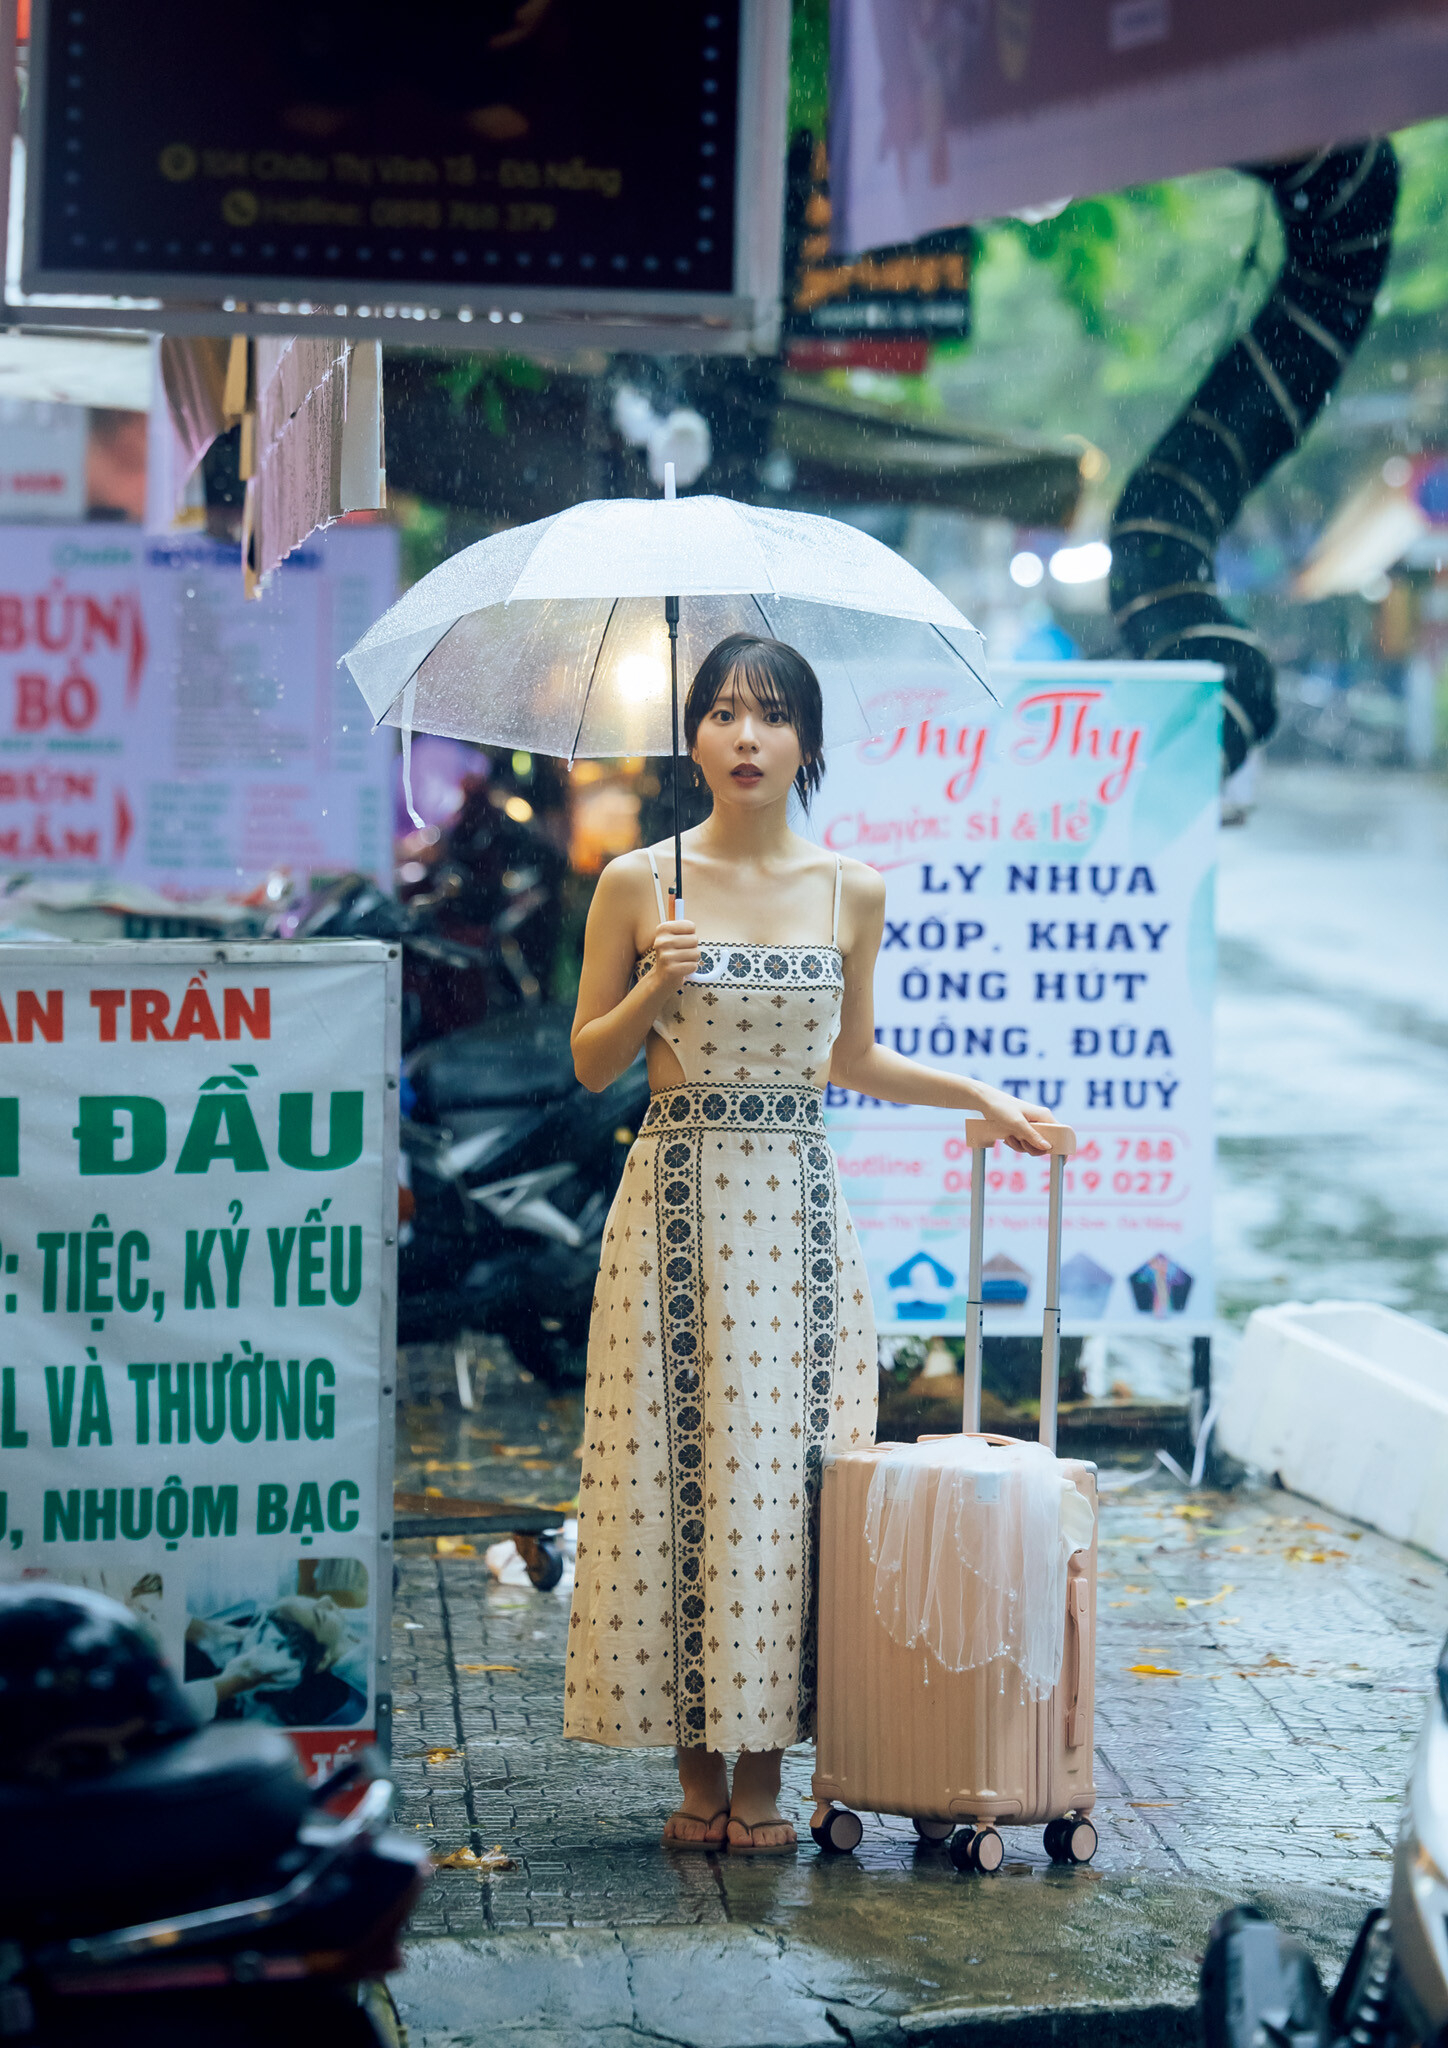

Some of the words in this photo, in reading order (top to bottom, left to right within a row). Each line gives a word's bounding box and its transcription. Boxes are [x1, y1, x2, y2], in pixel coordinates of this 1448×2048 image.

[1007, 690, 1143, 804] Thy
[1010, 811, 1038, 842] &
[920, 863, 984, 894] LY
[1007, 863, 1157, 898] NHỰA
[1028, 921, 1171, 950] KHAY
[90, 970, 271, 1042] TRẦN
[901, 961, 1008, 1001] ỐNG
[1034, 964, 1149, 1001] HÚT
[72, 1064, 364, 1175] ĐẦU
[1113, 1138, 1174, 1162] 788
[943, 1170, 1025, 1193] 098
[1111, 1170, 1174, 1194] 027
[37, 1213, 164, 1332] TIỆC,
[184, 1199, 250, 1310] KỶ
[266, 1198, 363, 1307] YẾU
[45, 1346, 112, 1447] VÀ
[127, 1341, 336, 1446] THƯỜNG
[43, 1475, 238, 1551] NHUỘM
[256, 1480, 360, 1545] BẠC
